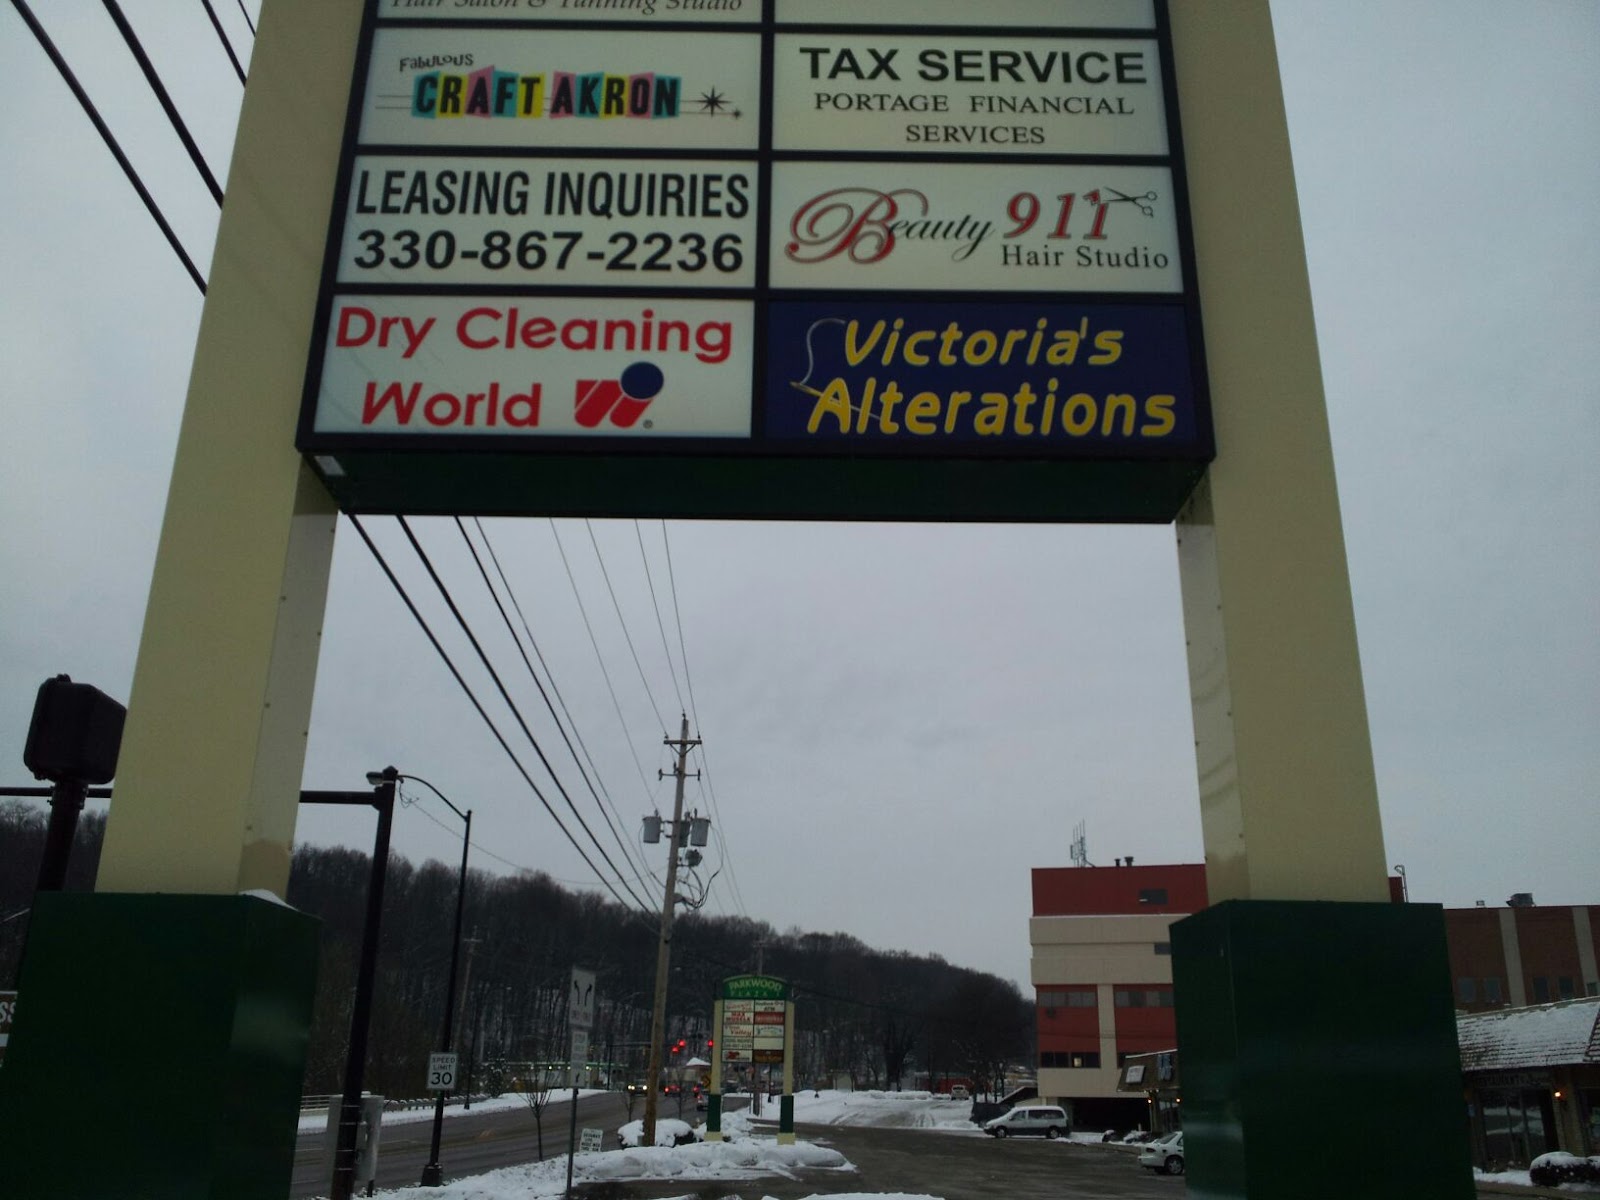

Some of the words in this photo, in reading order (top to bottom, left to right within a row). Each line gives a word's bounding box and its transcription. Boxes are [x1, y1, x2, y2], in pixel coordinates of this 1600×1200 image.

[800, 47, 902, 81] TAX
[917, 49, 1147, 84] SERVICE
[415, 75, 541, 115] CRAFT
[550, 73, 680, 116] AKRON
[814, 93, 949, 112] PORTAGE
[969, 96, 1134, 115] FINANCIAL
[906, 125, 1046, 144] SERVICES
[355, 170, 529, 216] LEASING
[544, 172, 750, 220] INQUIRIES
[784, 187, 996, 264] Beauty
[1003, 189, 1110, 241] 911
[354, 229, 744, 272] 330-867-2236
[1003, 244, 1065, 267] Hair
[1076, 246, 1169, 269] Studio
[336, 306, 436, 359] Dry
[456, 307, 733, 364] Cleaning
[845, 317, 1124, 367] Victoria's
[361, 381, 542, 427] World
[807, 377, 1177, 437] Alterations
[729, 979, 782, 991] PARKWOOD
[431, 1072, 453, 1085] 30
